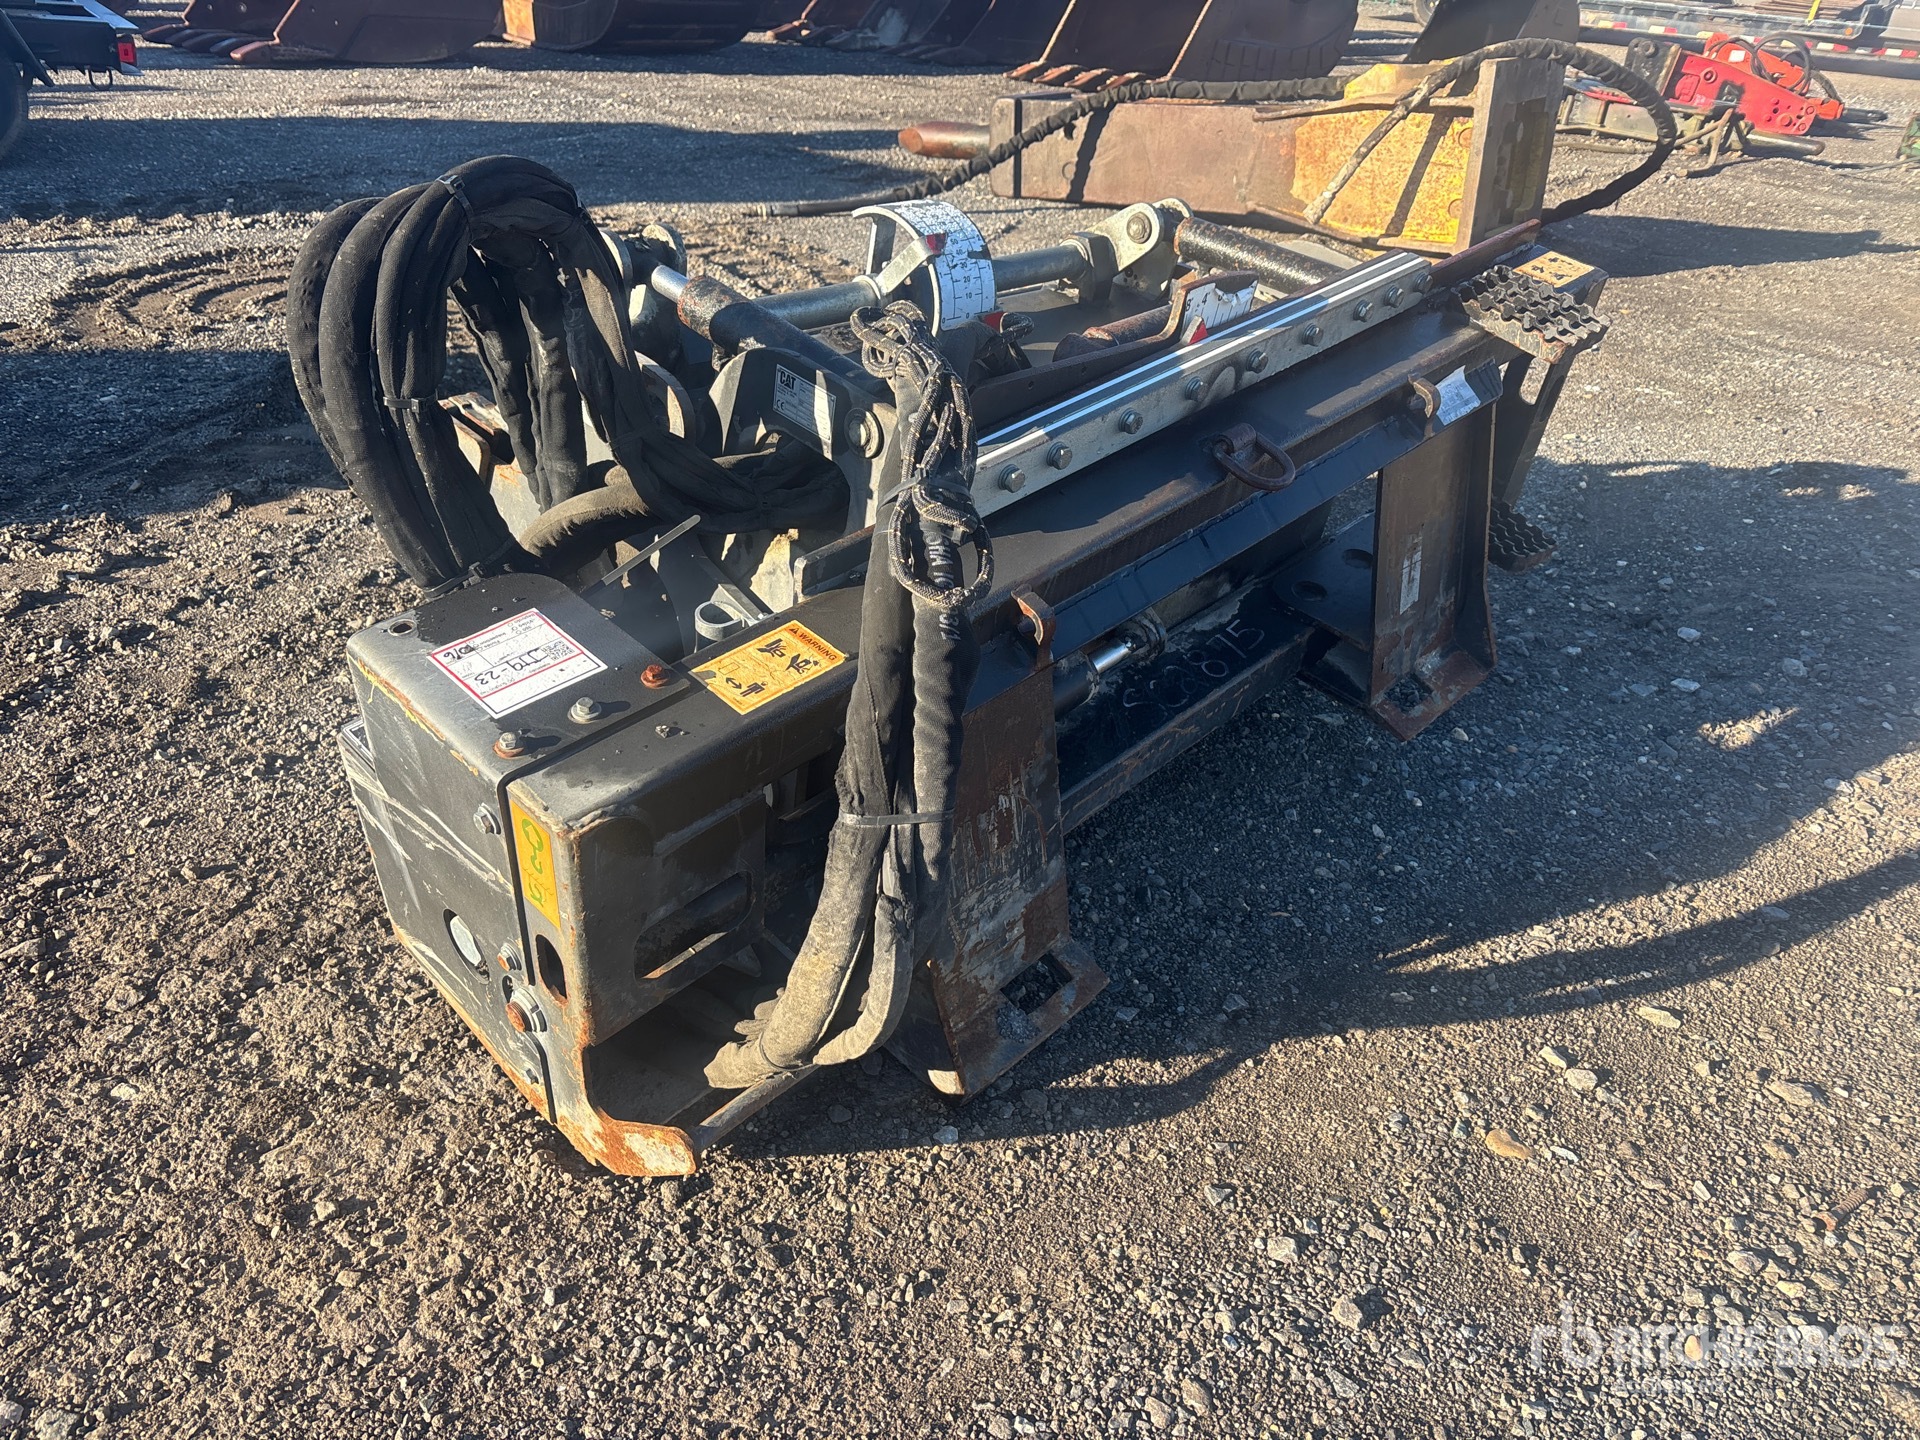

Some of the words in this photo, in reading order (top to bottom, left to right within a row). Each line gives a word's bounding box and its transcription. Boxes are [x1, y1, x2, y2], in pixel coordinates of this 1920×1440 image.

[963, 275, 971, 284] 20
[965, 291, 972, 300] 10
[780, 371, 796, 390] CAT
[799, 632, 838, 661] WARNING
